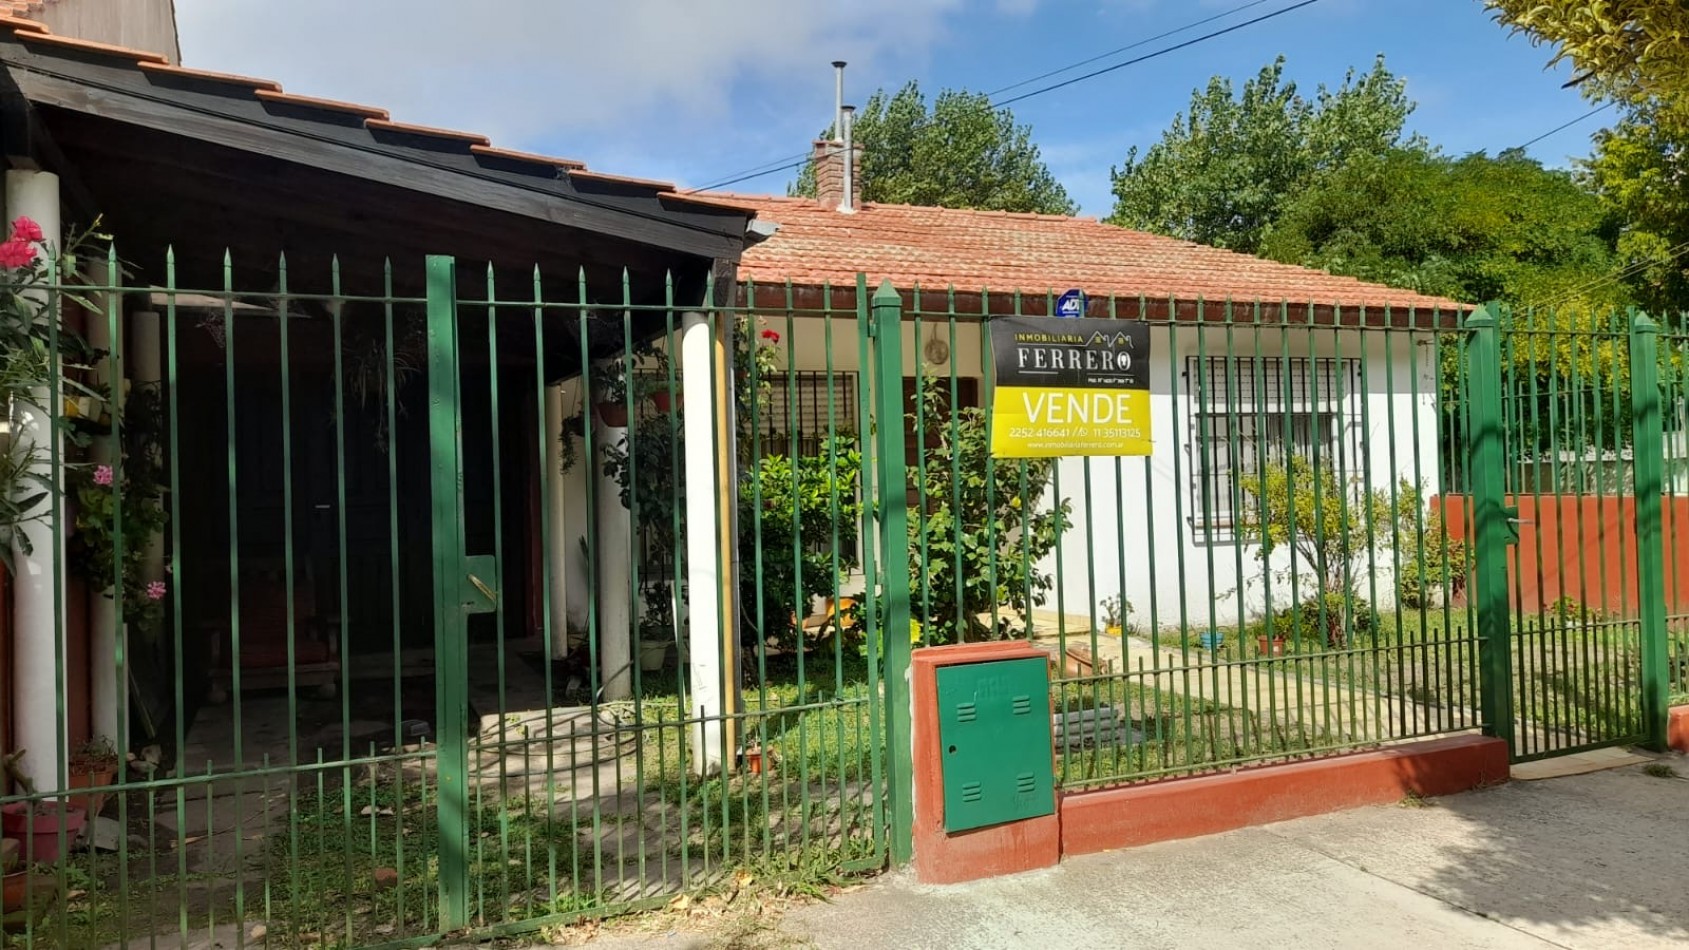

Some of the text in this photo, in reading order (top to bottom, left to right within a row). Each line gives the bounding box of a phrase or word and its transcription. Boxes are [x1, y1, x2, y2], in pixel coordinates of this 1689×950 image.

[1014, 333, 1084, 343] INMOBILIARIA
[1017, 347, 1132, 371] FERRERO
[1022, 392, 1132, 424] VENDE
[1009, 427, 1034, 438] 2252
[1036, 427, 1070, 438] 416641
[1093, 427, 1101, 438] 11
